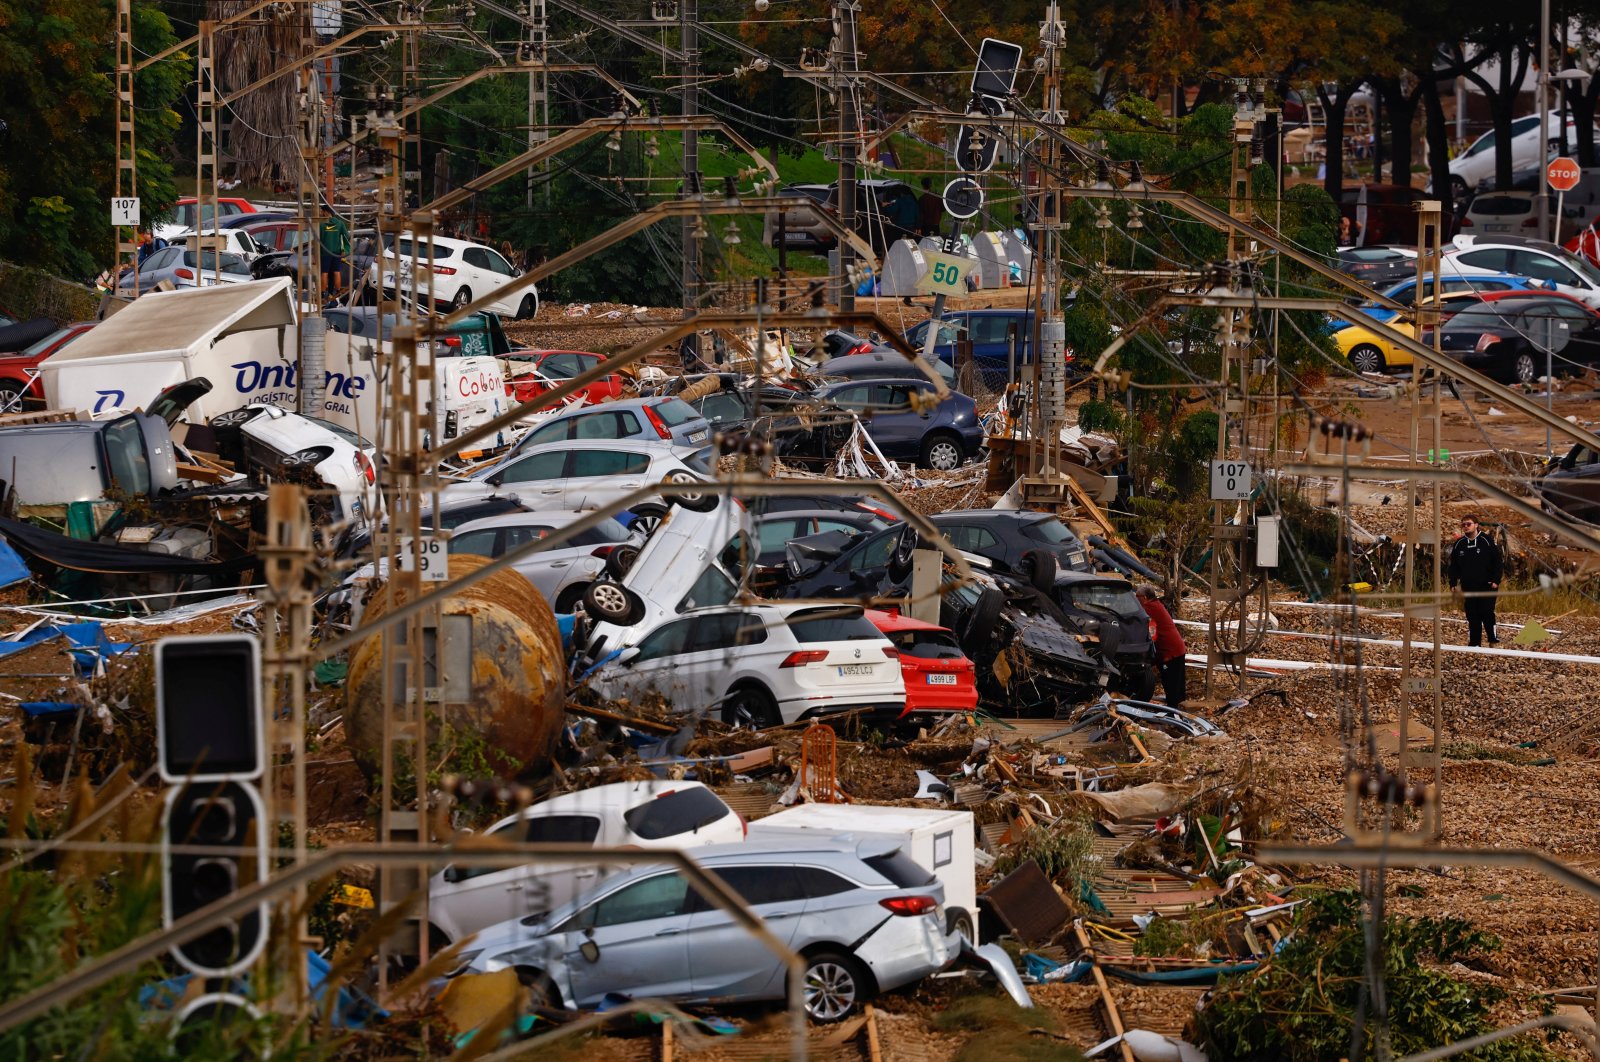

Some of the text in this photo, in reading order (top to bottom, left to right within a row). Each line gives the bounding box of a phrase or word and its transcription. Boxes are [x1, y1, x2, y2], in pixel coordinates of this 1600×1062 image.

[1549, 170, 1577, 178] STOP
[115, 200, 135, 208] 107
[123, 210, 128, 219] 1
[933, 262, 959, 285] 50
[1218, 464, 1246, 477] 107
[1227, 478, 1236, 491] 0
[406, 540, 439, 554] 106
[420, 557, 429, 571] 9
[843, 666, 859, 675] 4952
[931, 675, 945, 683] 4999
